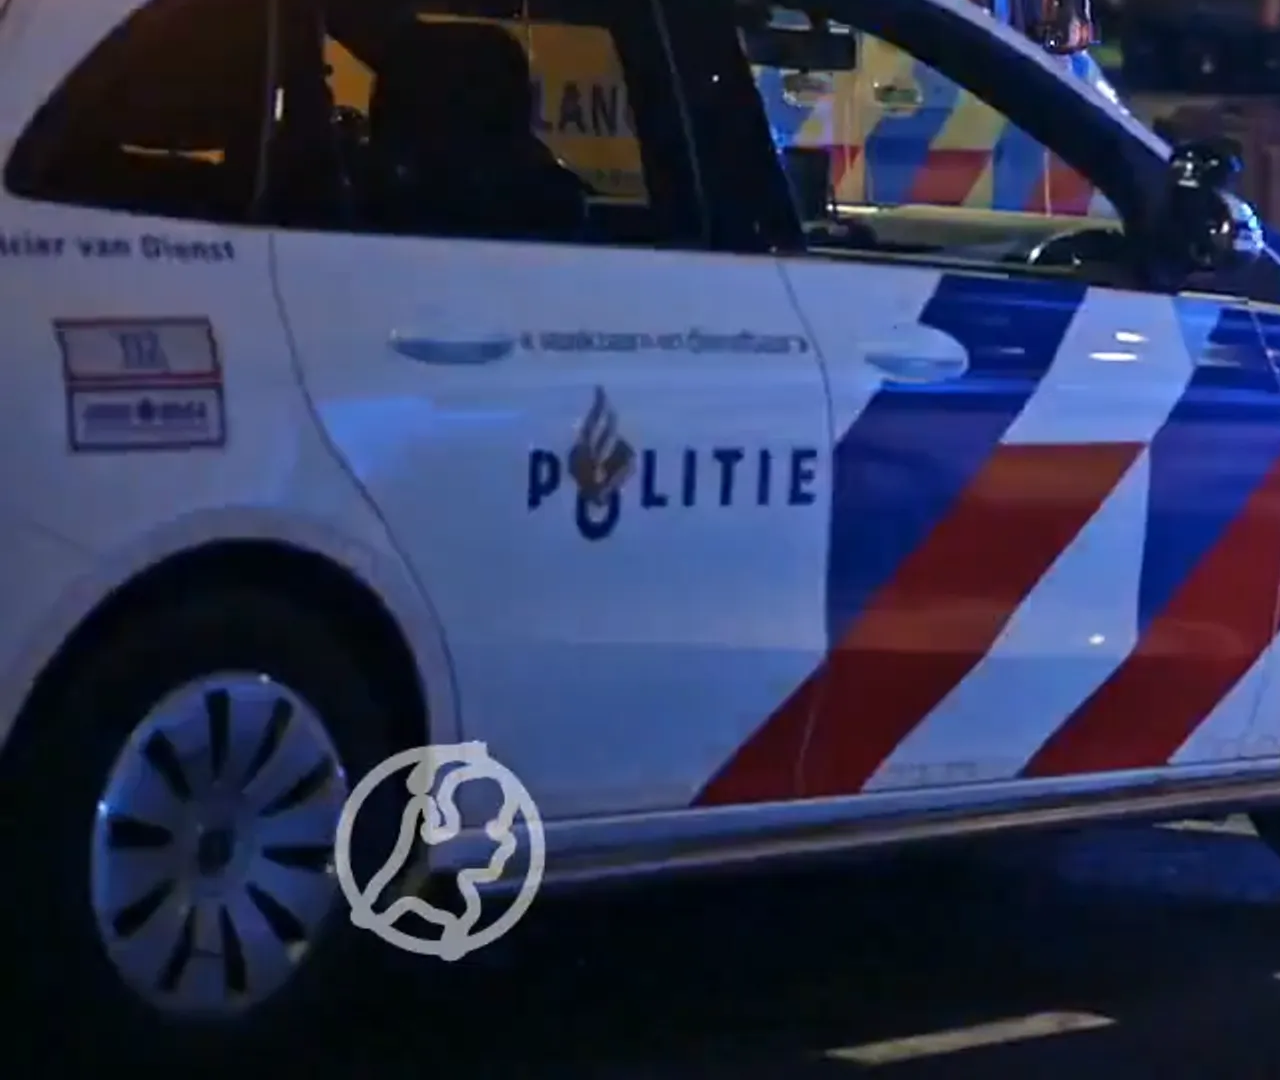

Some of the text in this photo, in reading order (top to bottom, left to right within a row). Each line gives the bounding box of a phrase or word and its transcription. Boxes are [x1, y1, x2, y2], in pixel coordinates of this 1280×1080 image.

[77, 236, 131, 258] van
[140, 234, 234, 262] Dienst
[528, 446, 818, 541] POLITIE
